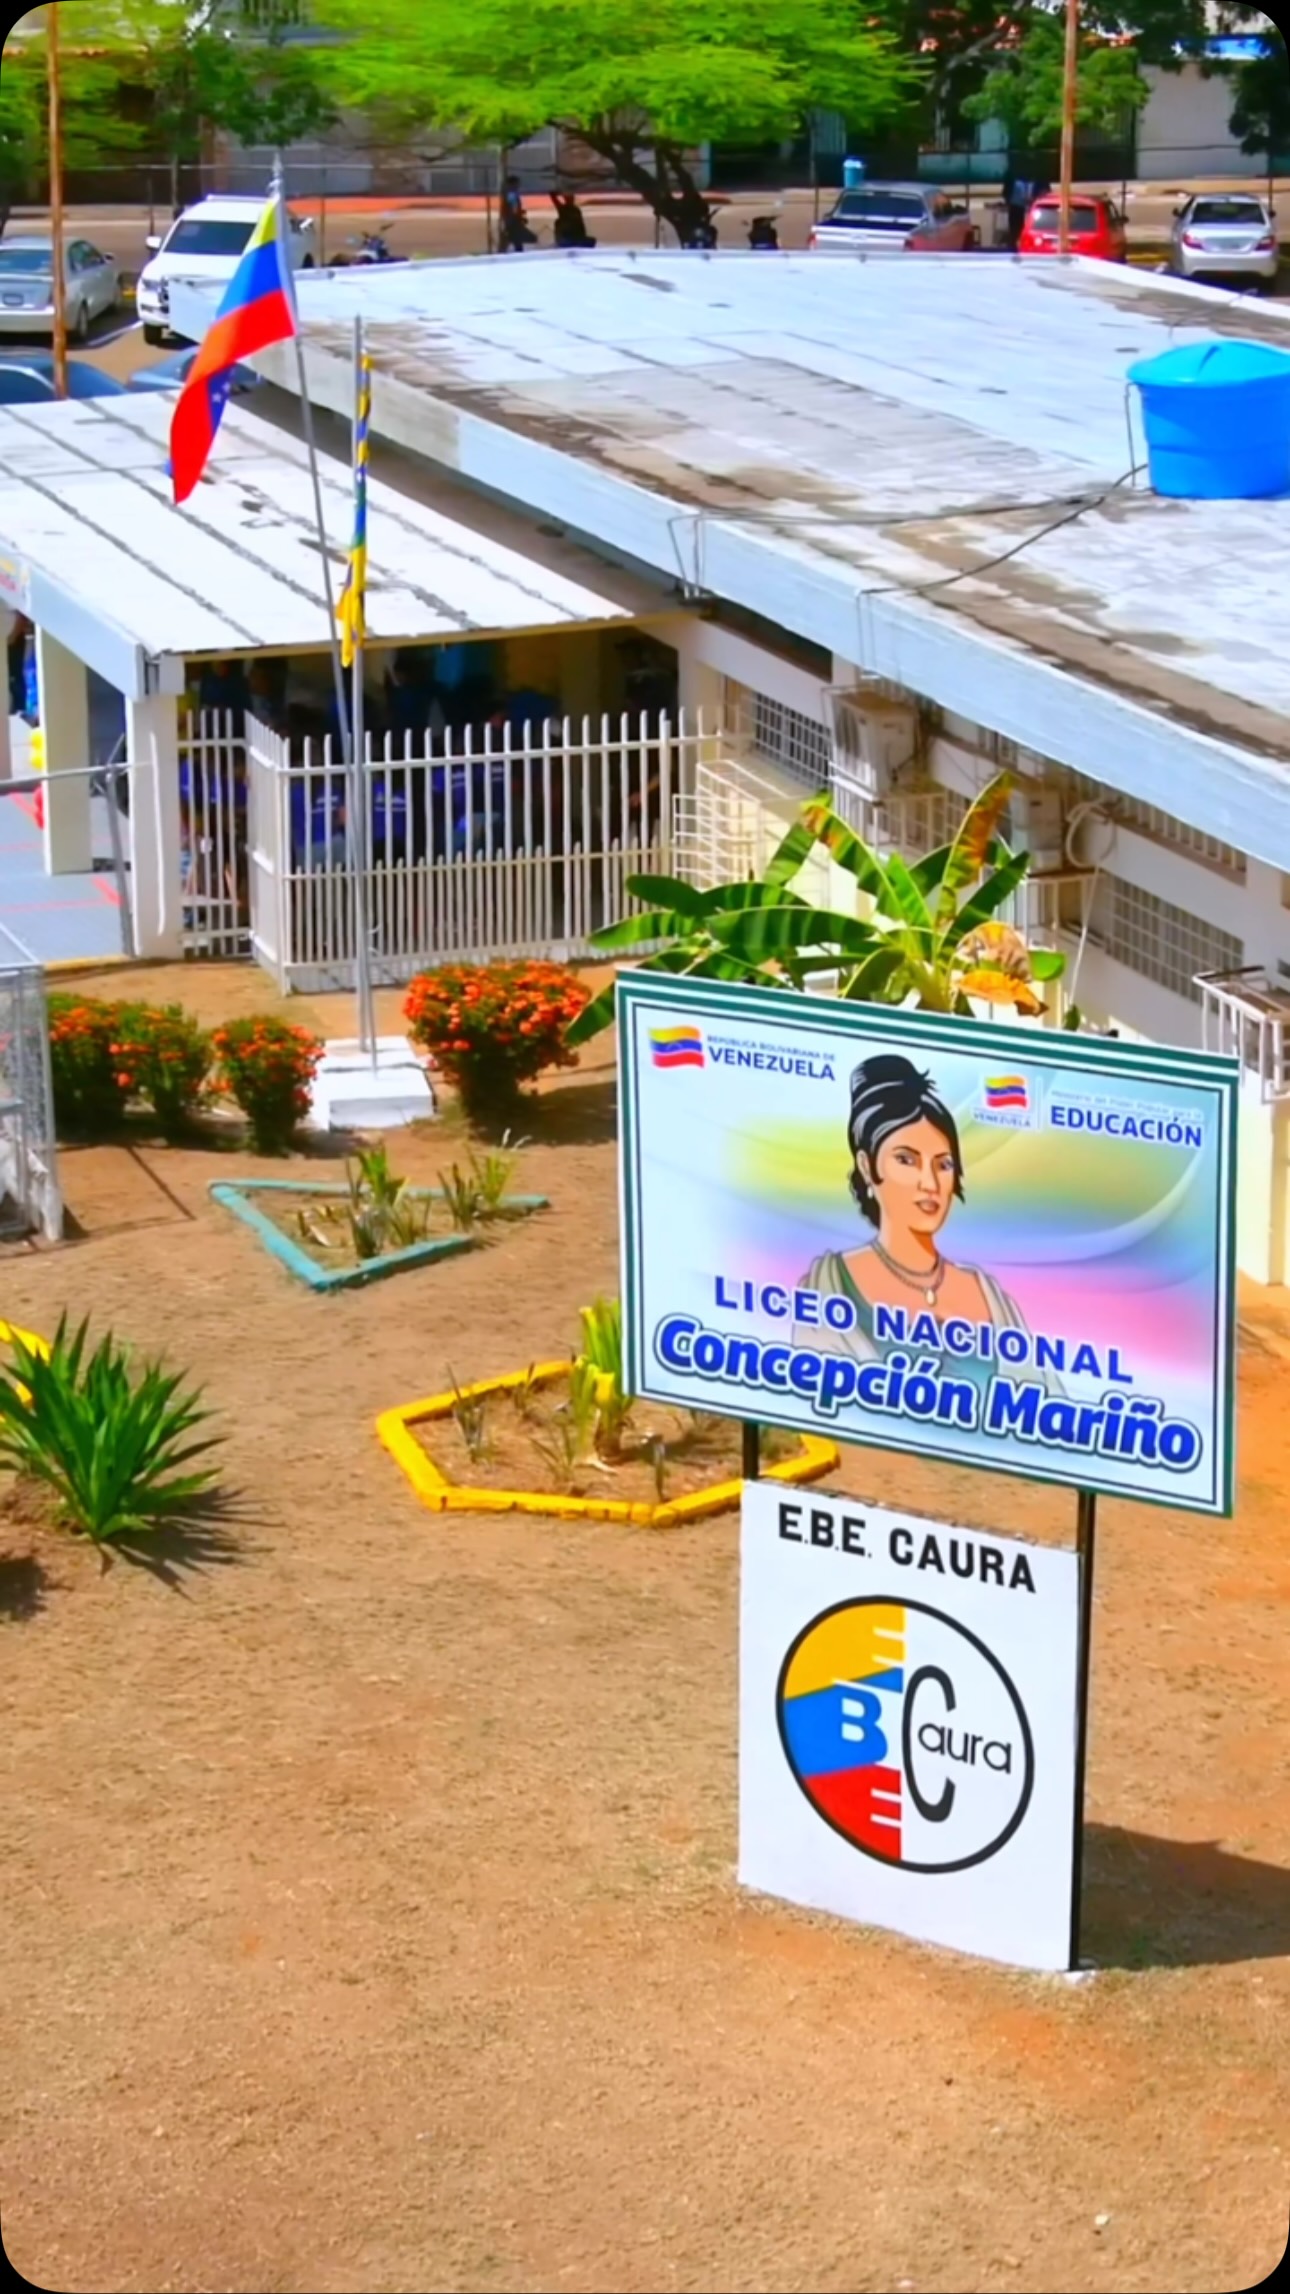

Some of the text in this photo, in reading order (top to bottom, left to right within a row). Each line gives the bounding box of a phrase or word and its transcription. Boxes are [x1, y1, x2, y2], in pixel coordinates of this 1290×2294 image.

[708, 1045, 836, 1082] VENEZUELA
[1051, 1105, 1202, 1148] EDUCACIÓN
[714, 1276, 1134, 1384] LICEO NACIONAL
[657, 1319, 1197, 1465] Concepción Mariño
[778, 1503, 1036, 1593] E.B.E. CAURA
